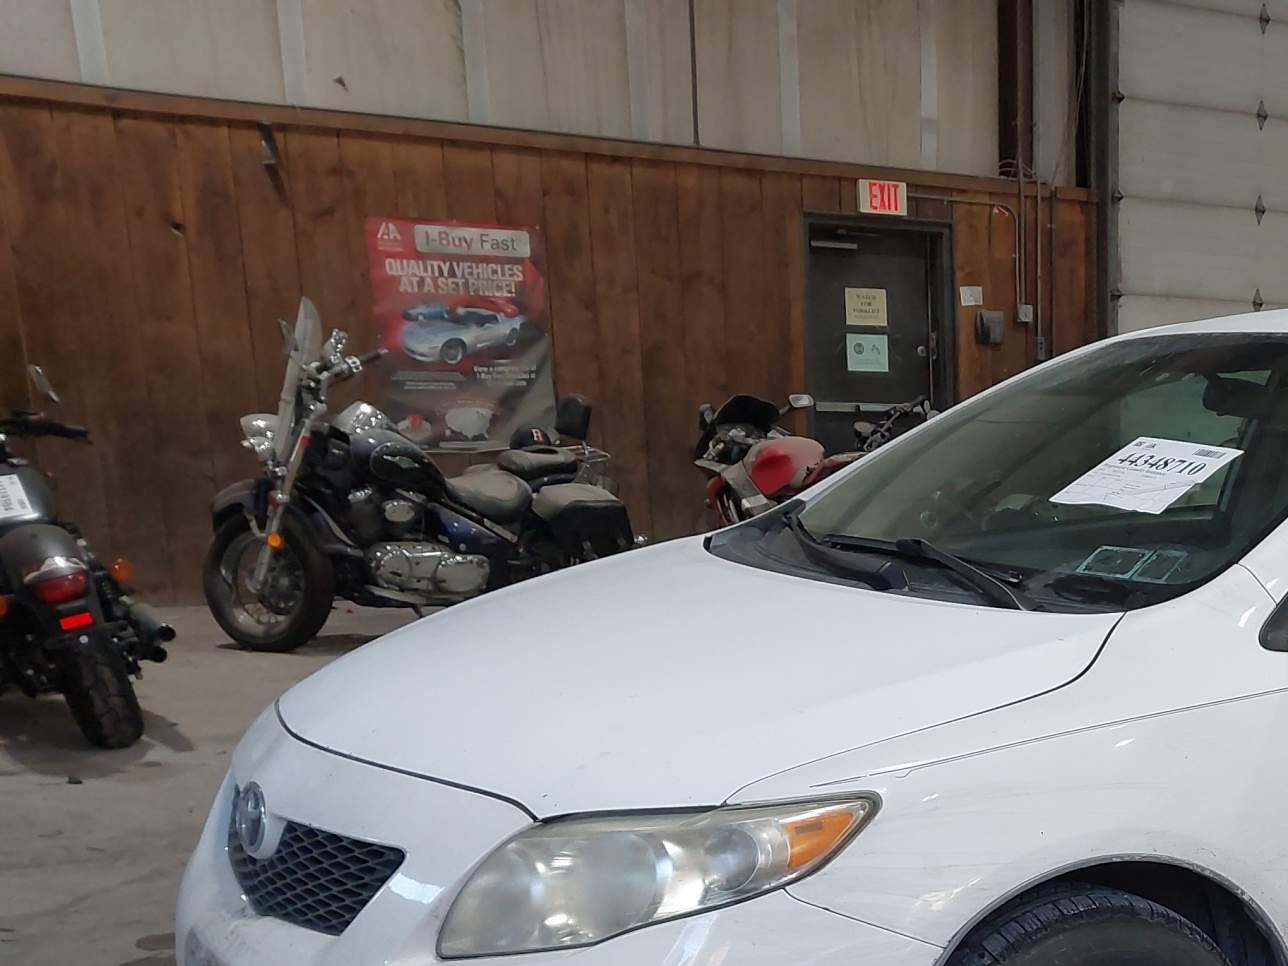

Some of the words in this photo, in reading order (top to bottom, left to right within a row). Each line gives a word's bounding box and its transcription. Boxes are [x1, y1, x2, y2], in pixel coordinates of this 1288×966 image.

[868, 182, 899, 211] EXIT
[425, 230, 472, 249] I-Buy
[480, 233, 517, 251] Fast
[385, 259, 450, 277] QUALITY
[452, 262, 523, 281] VEHICLES
[400, 277, 420, 293] AT
[423, 278, 438, 293] A
[438, 278, 466, 295] SET
[469, 280, 516, 297] PRICE!
[1118, 452, 1207, 476] 44348710
